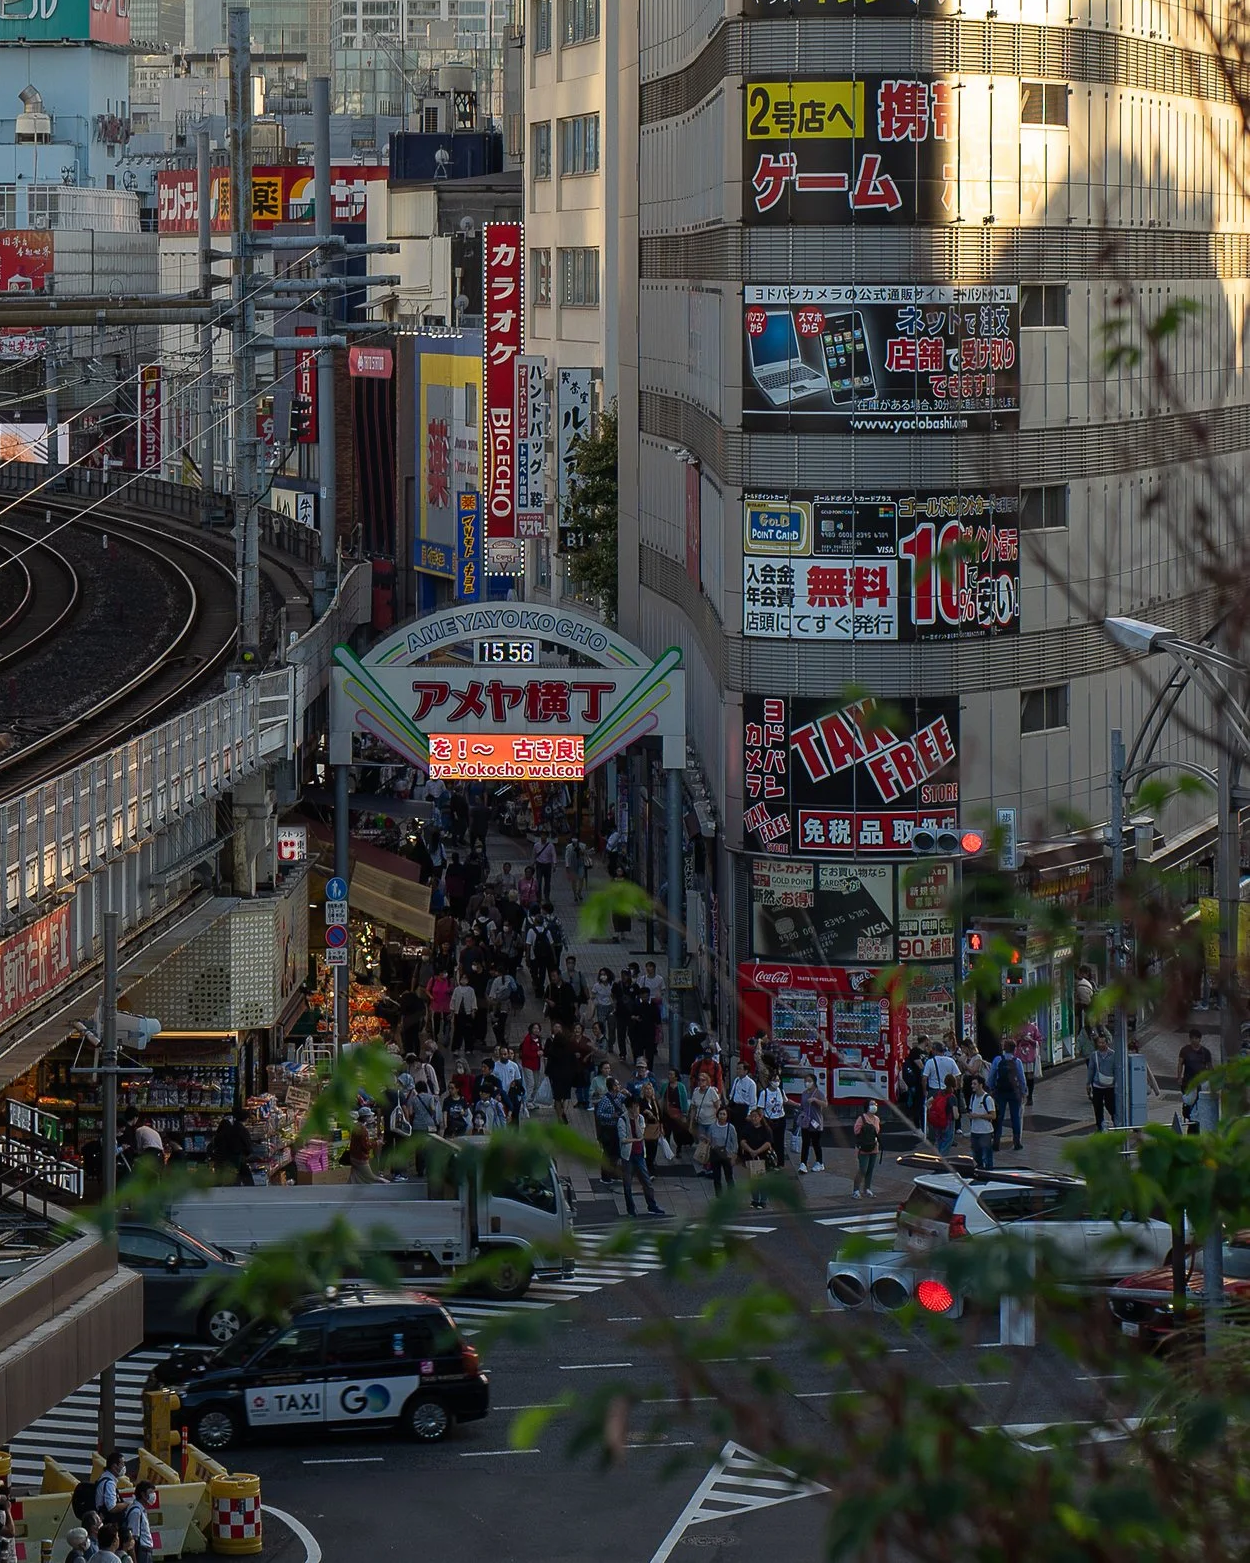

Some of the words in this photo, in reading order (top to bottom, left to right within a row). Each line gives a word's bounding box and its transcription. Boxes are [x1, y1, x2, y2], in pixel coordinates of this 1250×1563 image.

[749, 88, 857, 136] 2号店へ
[752, 153, 902, 212] ゲーム
[491, 243, 518, 366] カラオケ
[755, 288, 946, 301] ヨドバシカメラの公式通販サイト
[750, 323, 763, 333] から
[798, 312, 823, 322] スマホ
[801, 323, 820, 334] から
[896, 306, 1010, 336] ネットで注文
[885, 337, 1015, 372] 店舗で受け取り
[491, 408, 511, 449] BIG
[492, 454, 511, 518] ECHO
[752, 529, 774, 539] POINT
[877, 546, 894, 554] VISA
[746, 564, 795, 586] 入会金
[806, 566, 890, 608] 無料
[899, 520, 968, 625] 10
[746, 586, 795, 608] 年会費
[407, 609, 608, 653] AMEYAYOKOCHO
[746, 611, 894, 634] 店頭にてすぐ発行
[412, 681, 616, 723] アメヤ横丁
[745, 722, 762, 798] カメラ
[763, 699, 786, 798] ヨドバシ
[864, 714, 956, 804] FREE
[922, 784, 958, 803] STORE
[744, 801, 771, 833] TAX
[759, 813, 790, 843] FREE
[766, 843, 788, 853] STORE
[753, 862, 813, 875] ヨドバシカメラ
[772, 877, 790, 885] GOLD
[792, 878, 813, 886] POINT
[819, 867, 887, 878] でお買い物なら
[862, 922, 891, 938] VISA
[274, 1393, 320, 1412] TAXI
[340, 1384, 391, 1415] GO
